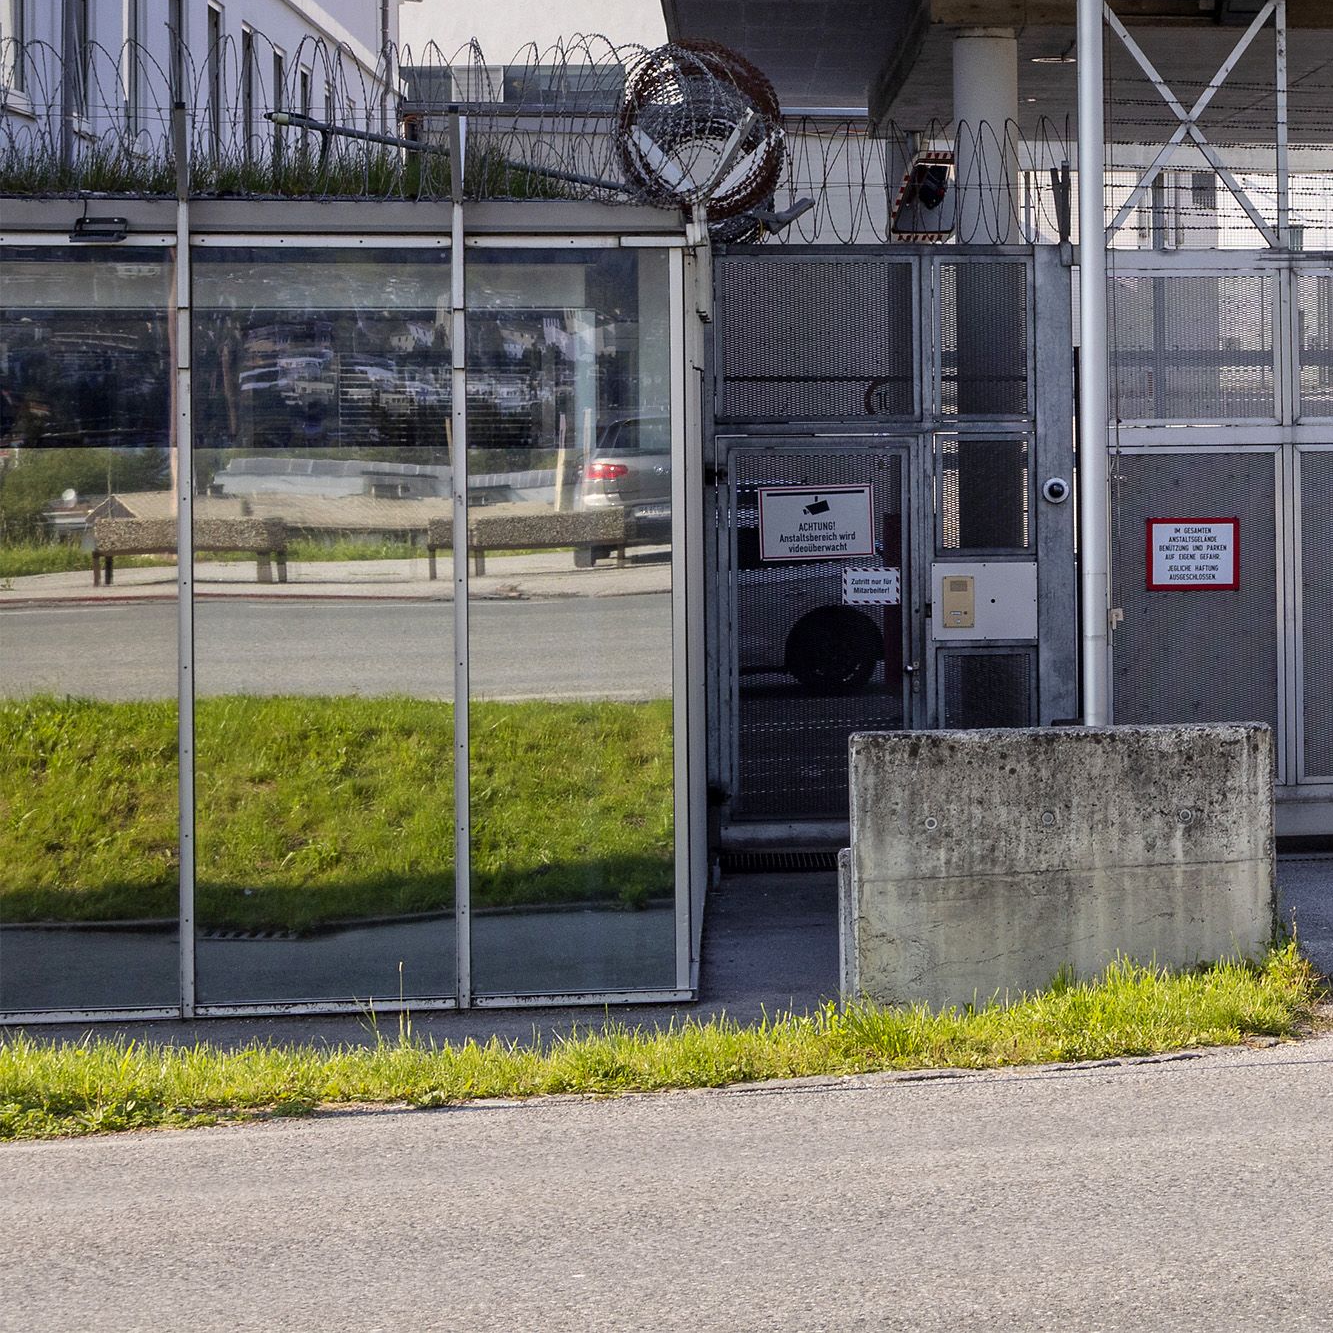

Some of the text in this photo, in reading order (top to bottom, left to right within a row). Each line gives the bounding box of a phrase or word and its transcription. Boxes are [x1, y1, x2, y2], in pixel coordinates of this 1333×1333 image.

[799, 522, 836, 532] ACHTUNG!
[780, 532, 856, 543] Anstaltsbereich wird
[788, 543, 848, 553] videoüberwacht
